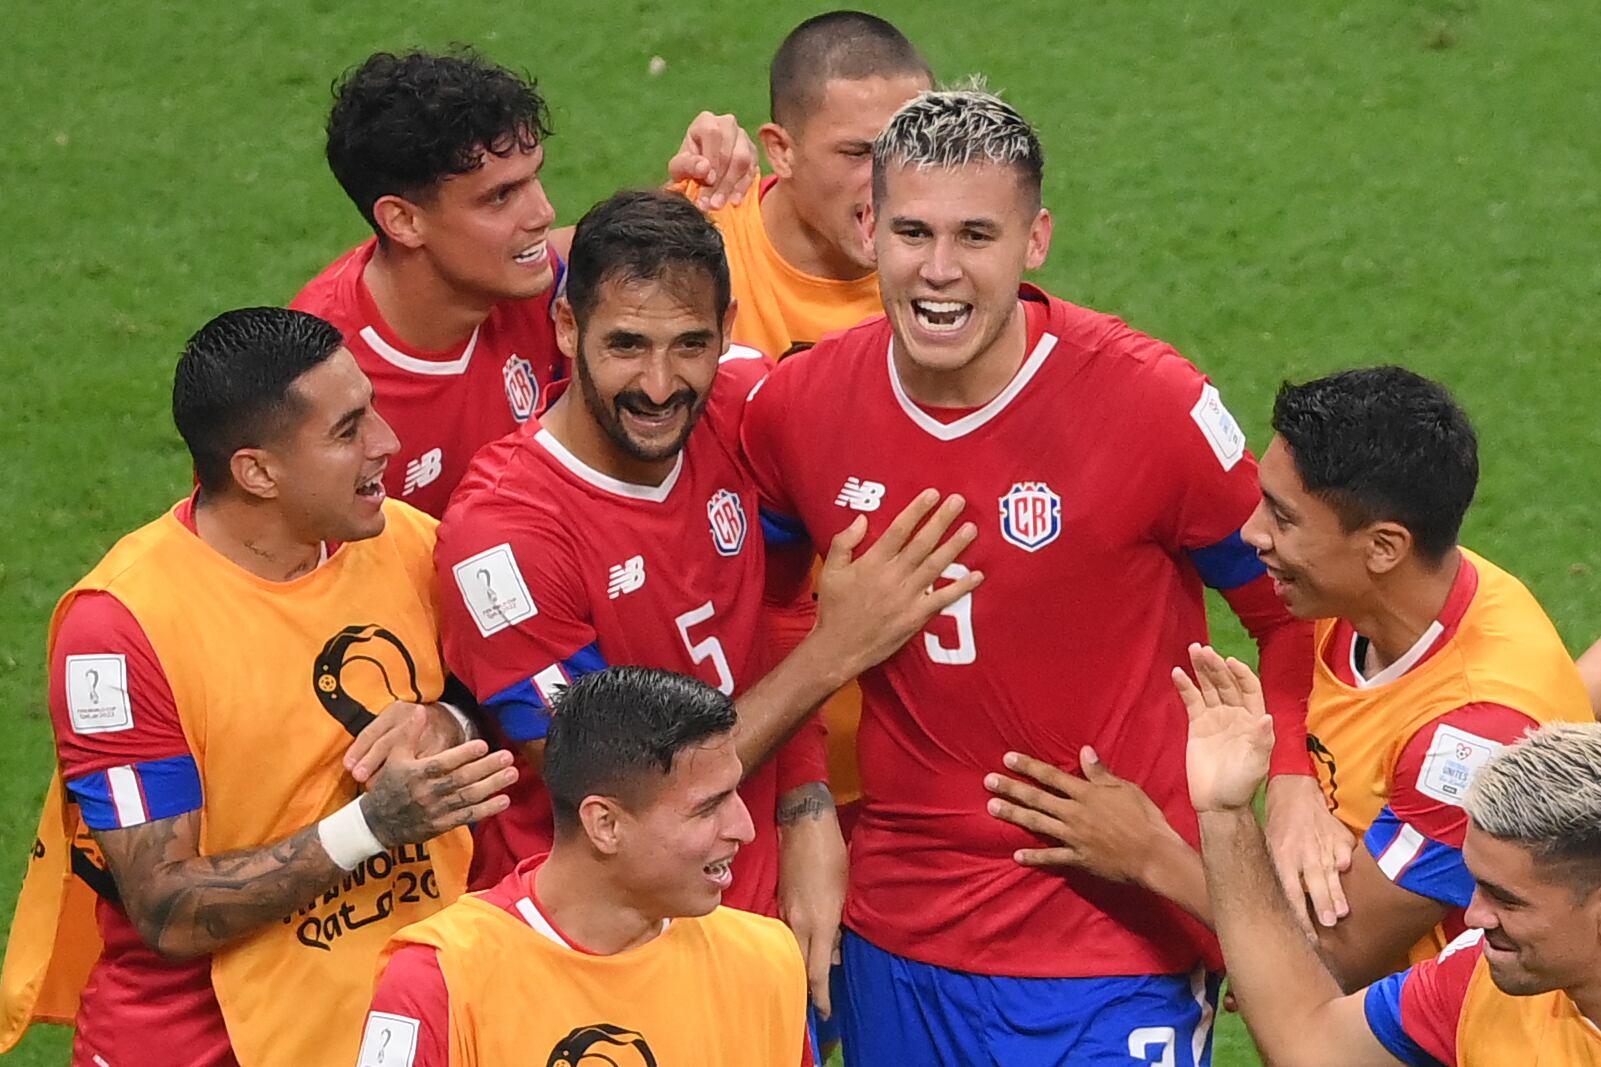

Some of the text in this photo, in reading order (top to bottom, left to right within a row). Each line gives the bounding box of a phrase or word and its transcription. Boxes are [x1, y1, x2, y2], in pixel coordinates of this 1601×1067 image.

[1014, 496, 1048, 539] CR
[674, 599, 735, 697] 5
[296, 886, 394, 952] Qata
